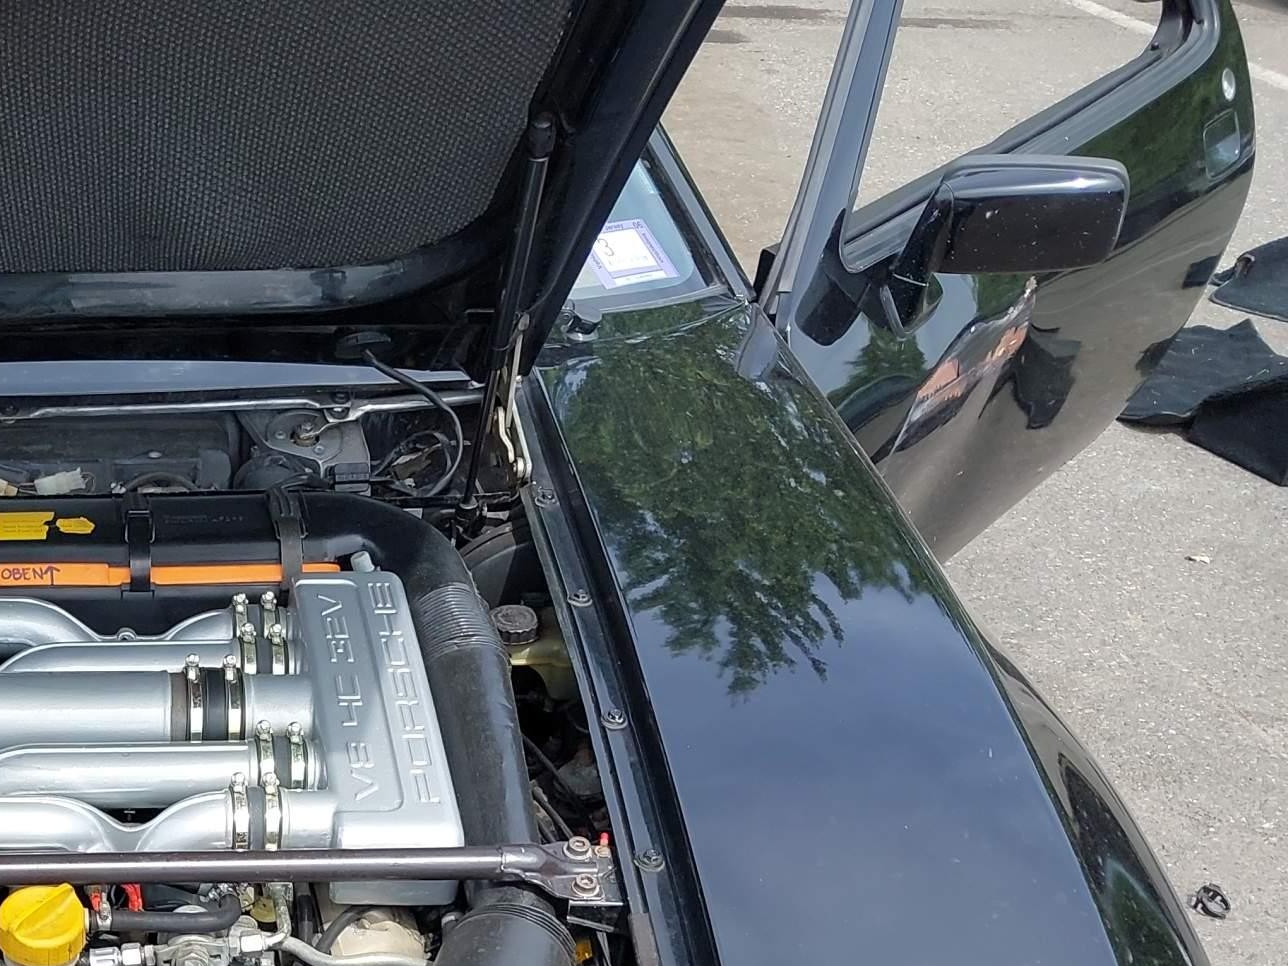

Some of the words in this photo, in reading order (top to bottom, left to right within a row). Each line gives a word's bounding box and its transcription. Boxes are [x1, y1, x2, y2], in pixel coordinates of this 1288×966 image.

[0, 568, 44, 581] OBEN
[366, 582, 440, 805] PORSCHE
[344, 741, 379, 802] V8
